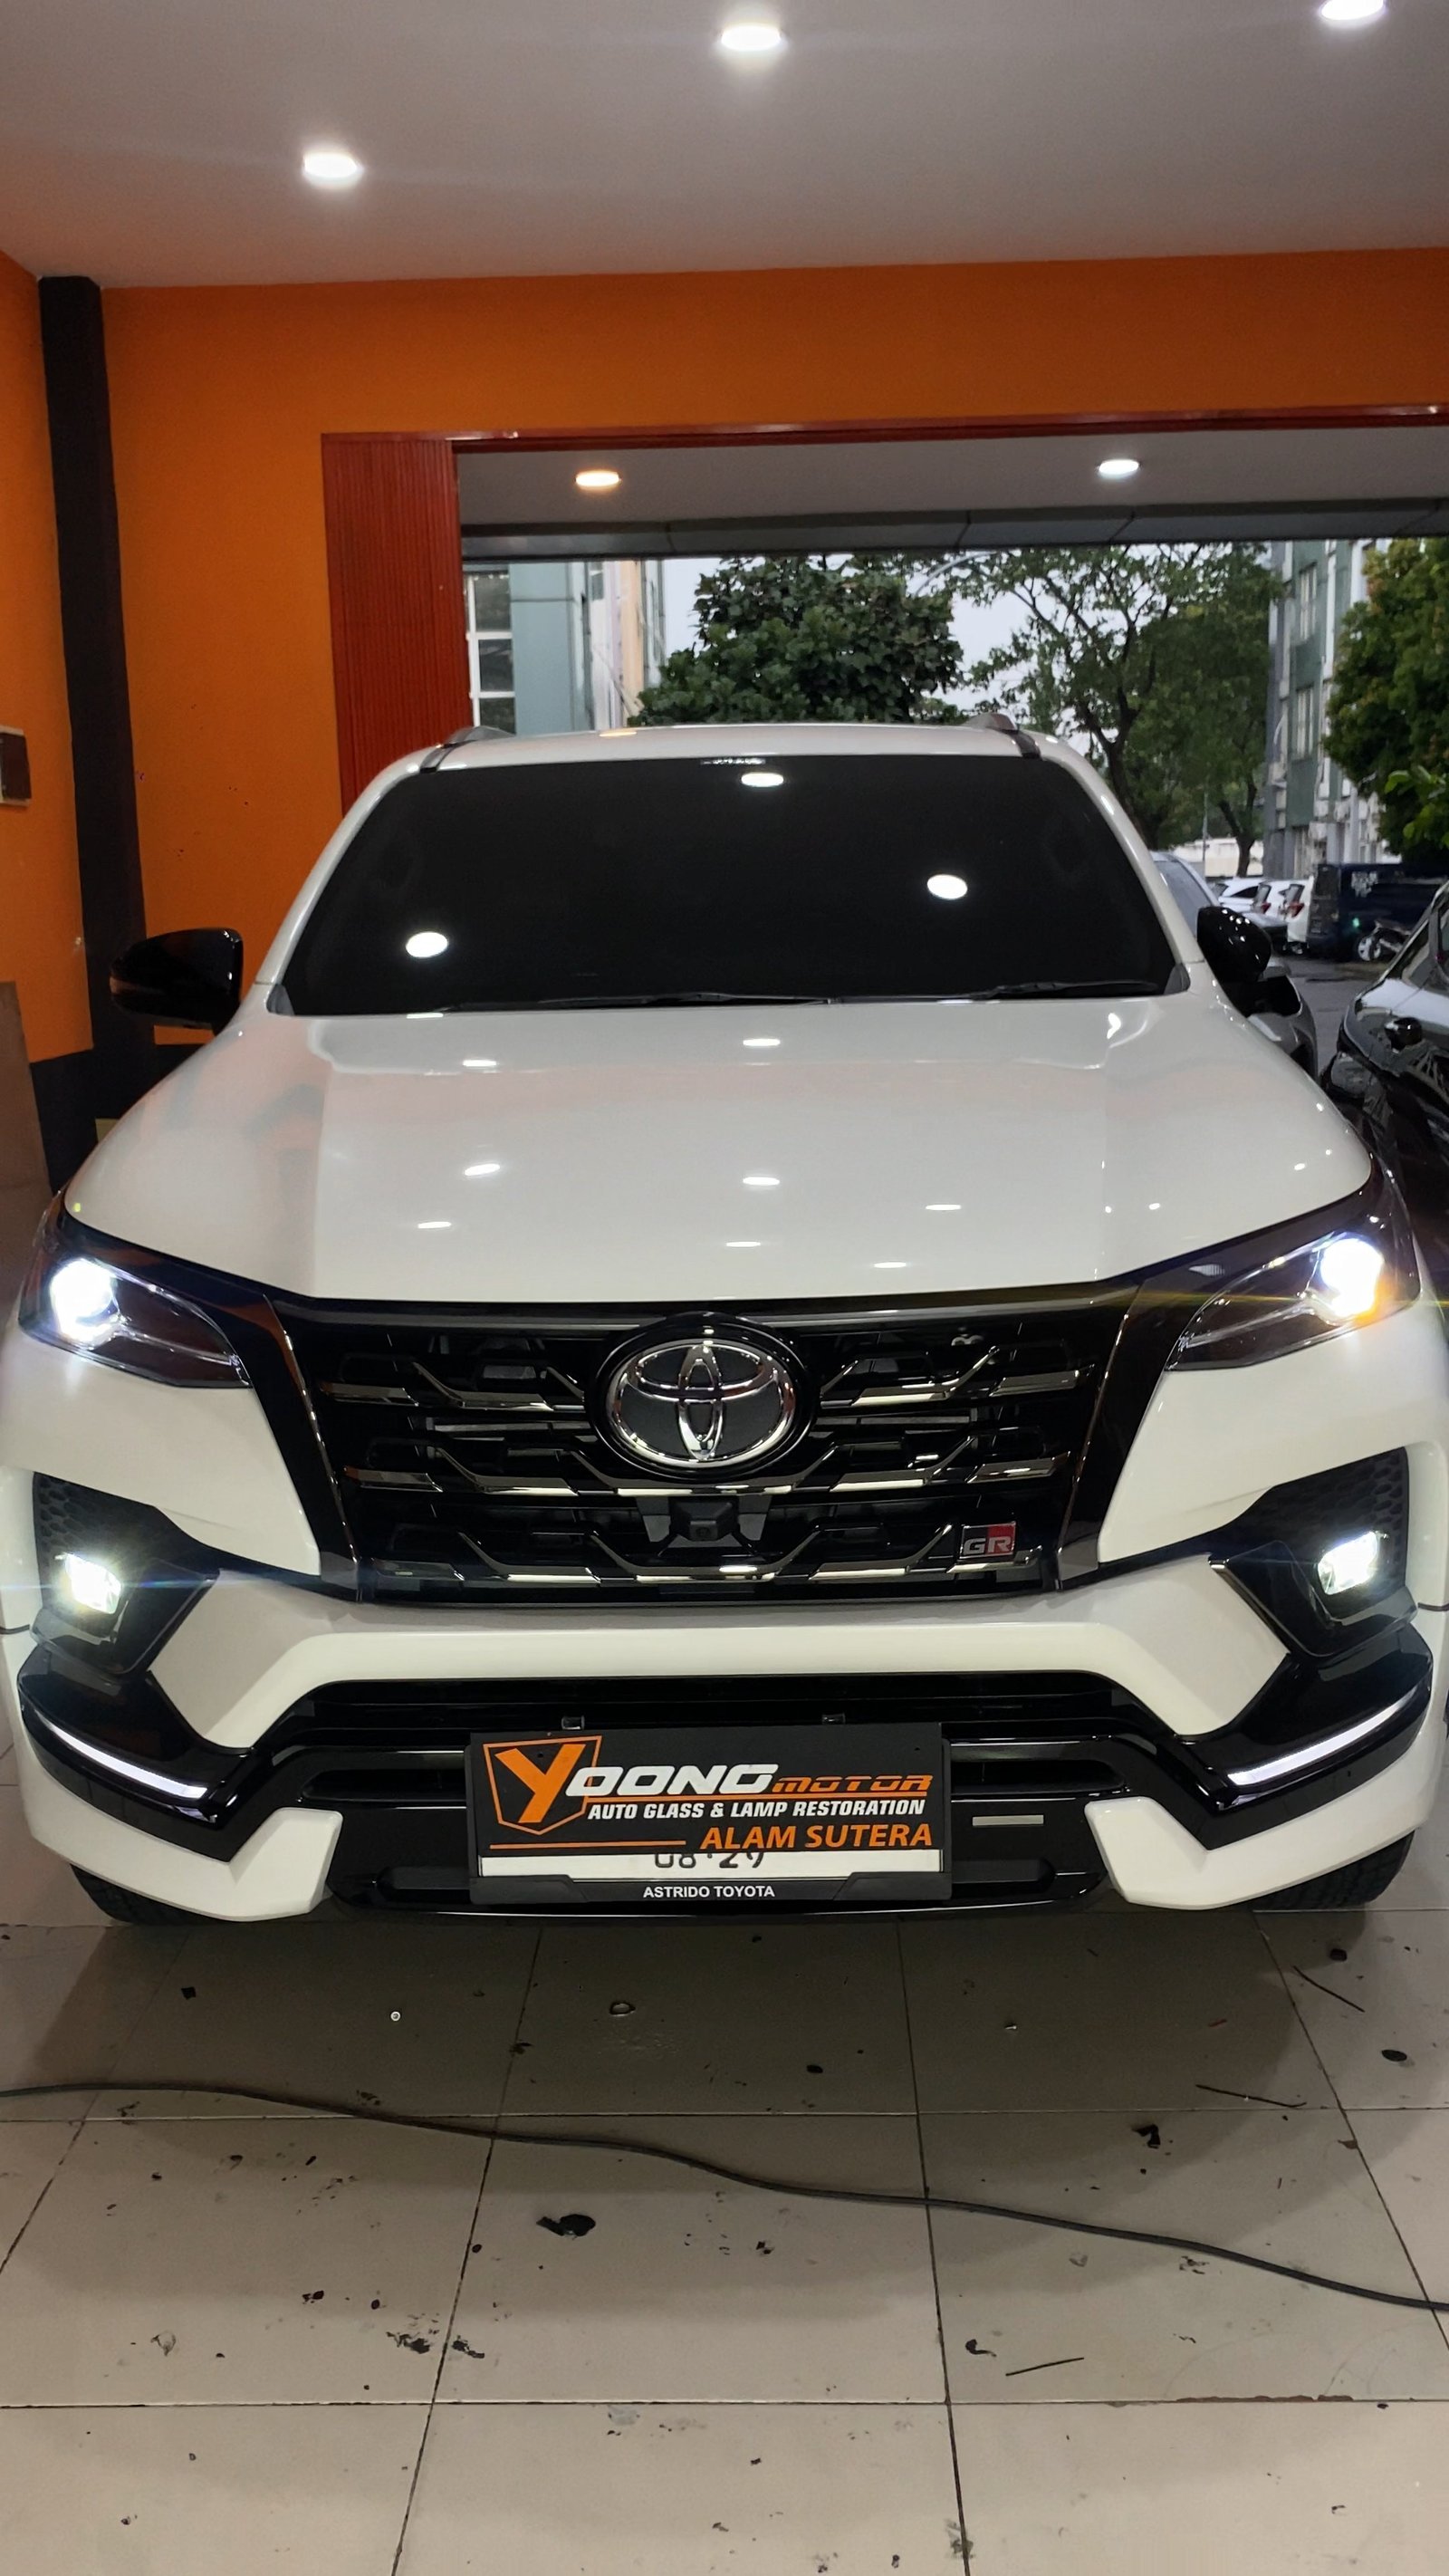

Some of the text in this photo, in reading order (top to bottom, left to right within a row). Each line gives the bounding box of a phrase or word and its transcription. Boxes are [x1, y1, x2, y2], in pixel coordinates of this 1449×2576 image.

[963, 1536, 1012, 1555] GR
[494, 1744, 779, 1823] YOONG
[588, 1800, 926, 1820] AUTO GLASS & LAMP RESTORATION
[699, 1823, 933, 1850] ALAM SUTERA
[643, 1885, 775, 1898] ASTRIDO TOYOTA
